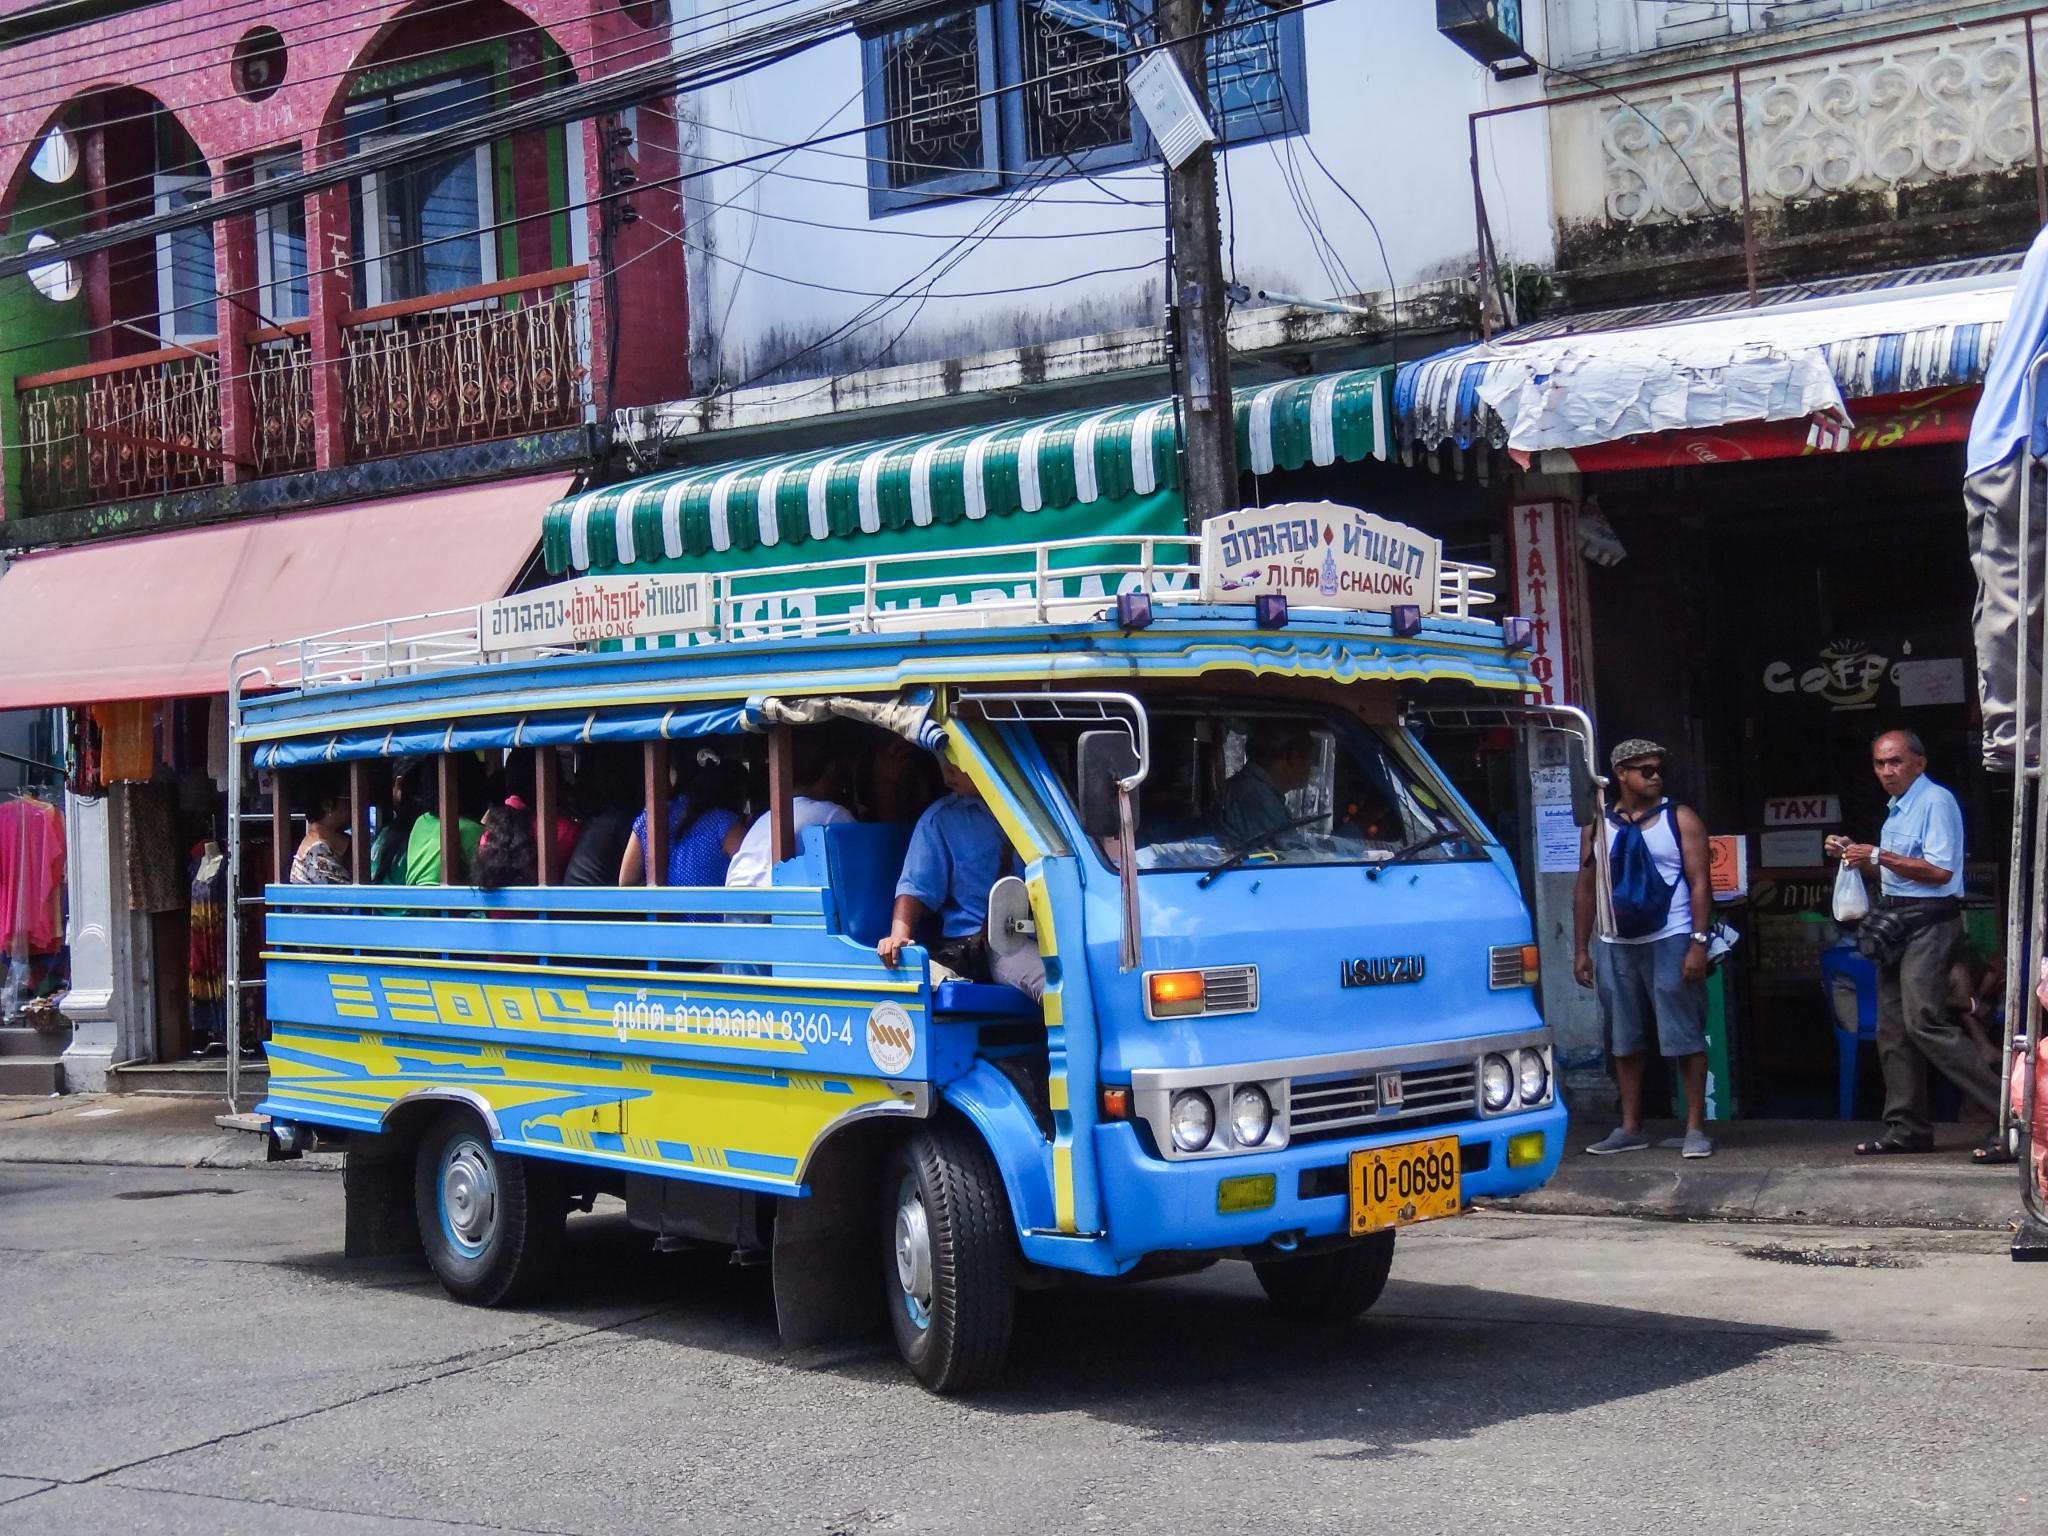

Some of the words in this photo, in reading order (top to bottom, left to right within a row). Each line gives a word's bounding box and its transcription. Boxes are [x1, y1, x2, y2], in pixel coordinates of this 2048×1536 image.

[1220, 518, 1319, 568] อ่าวฉลอง
[1342, 513, 1425, 579] ห้าแยก
[1266, 554, 1320, 595] ภูเก็ต
[1340, 570, 1414, 596] CHALONG
[492, 598, 564, 635] อ่าวฉลอง
[645, 578, 698, 618] ห้าแยก
[573, 621, 634, 640] CHALONG
[1770, 800, 1828, 820] TAXI
[1341, 954, 1425, 989] ISUZU
[612, 988, 775, 1042] ภูเก็ต-อ่าวฉลอง
[780, 1010, 853, 1046] 8360-4
[1363, 1152, 1455, 1206] 10-0699
